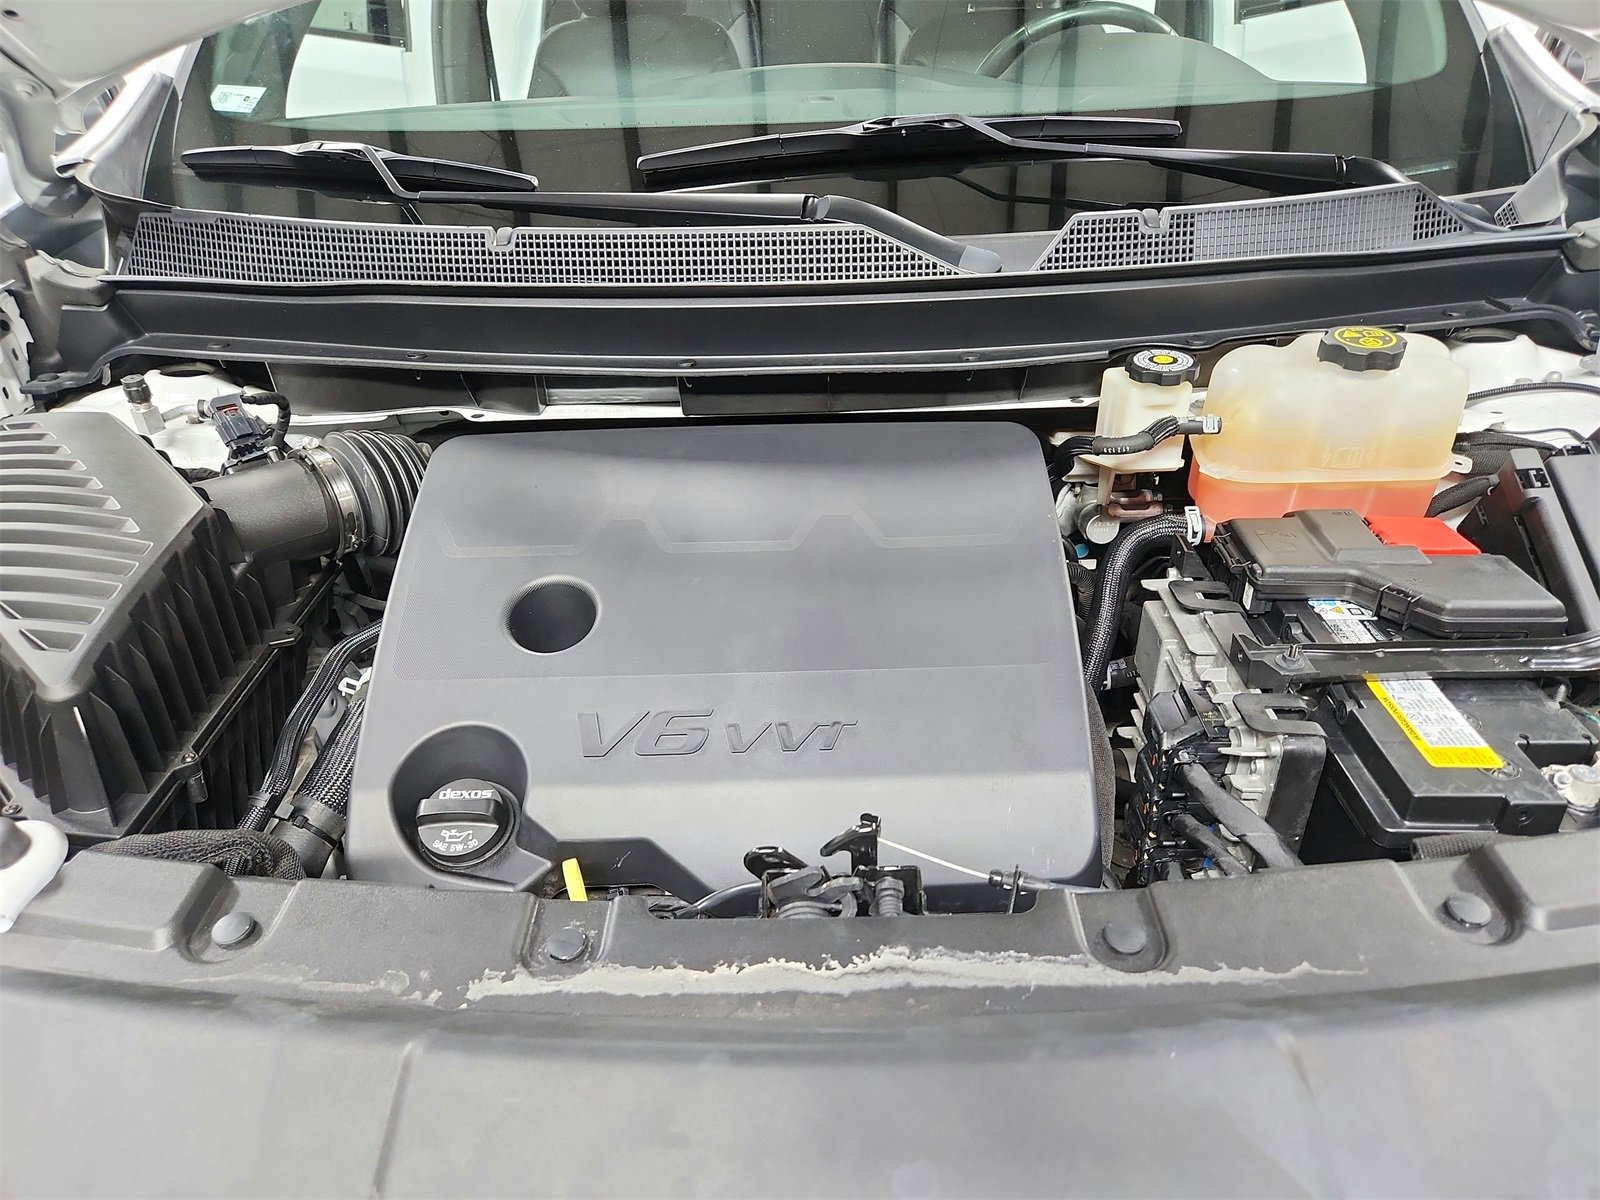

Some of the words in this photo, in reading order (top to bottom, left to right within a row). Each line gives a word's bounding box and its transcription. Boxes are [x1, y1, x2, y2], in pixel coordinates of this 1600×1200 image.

[576, 708, 715, 758] V6
[724, 720, 858, 753] VVT
[439, 788, 495, 800] dexos
[432, 840, 448, 852] SAE
[450, 840, 479, 852] 5W-30
